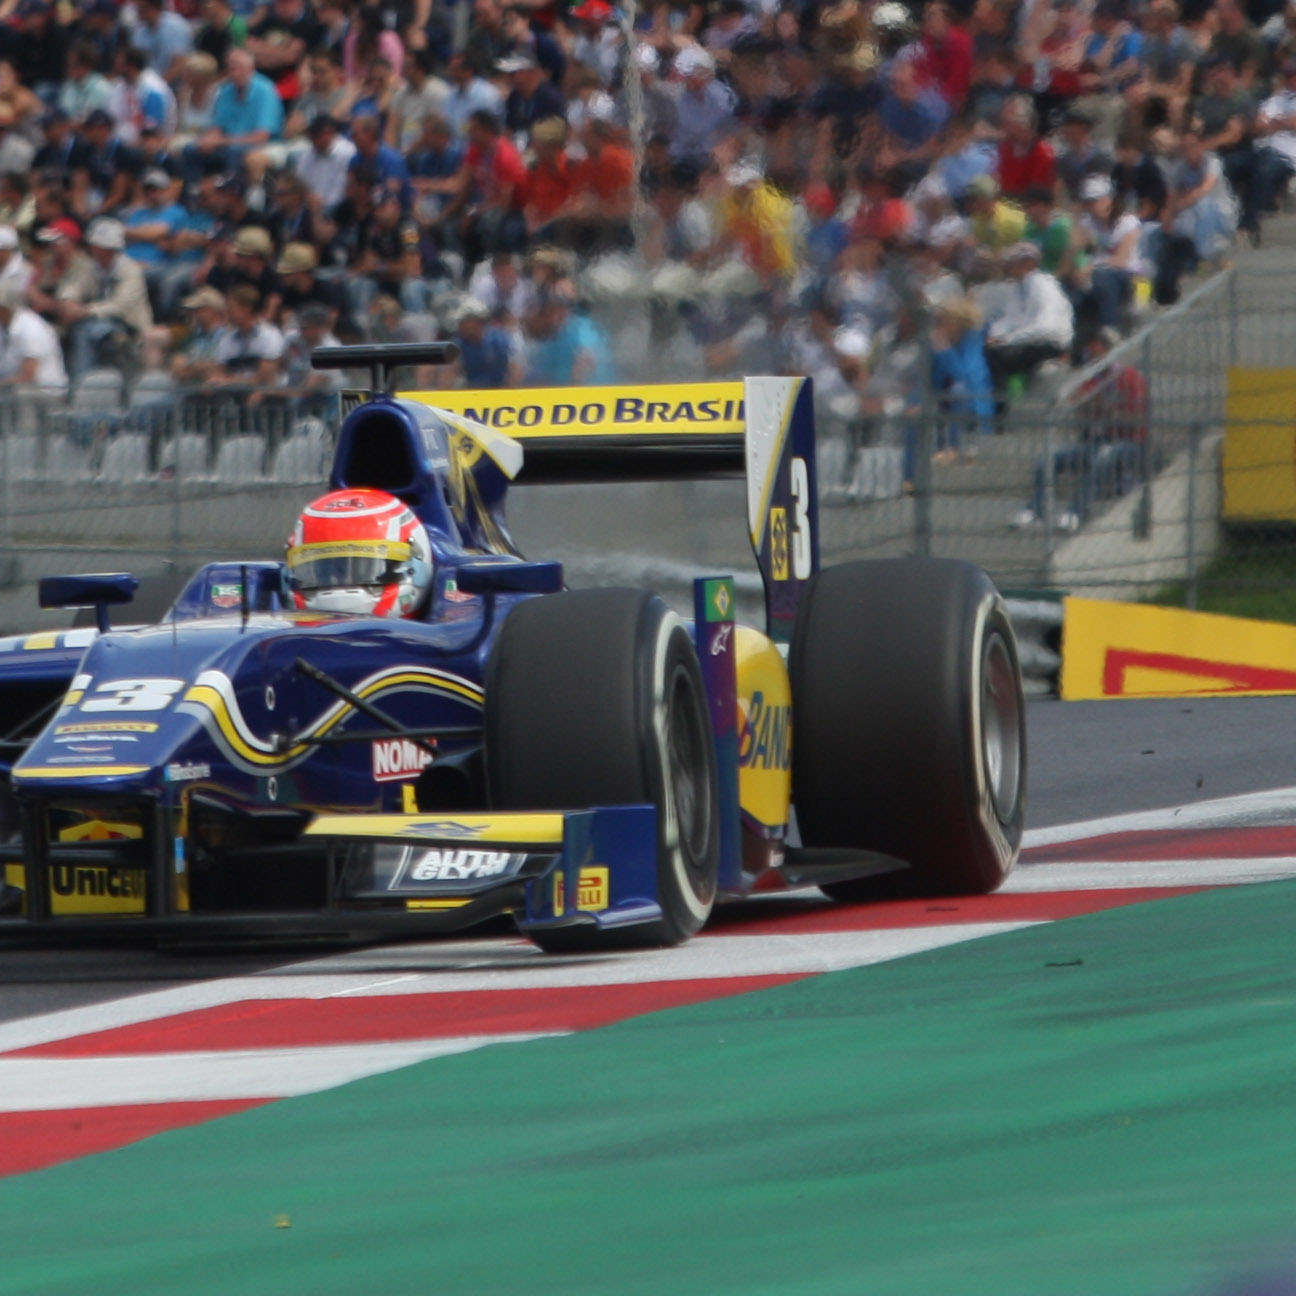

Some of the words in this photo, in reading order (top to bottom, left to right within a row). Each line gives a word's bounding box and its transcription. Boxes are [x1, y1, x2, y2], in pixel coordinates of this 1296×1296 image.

[551, 401, 605, 426] DO
[790, 457, 813, 581] 3
[79, 677, 186, 713] 3
